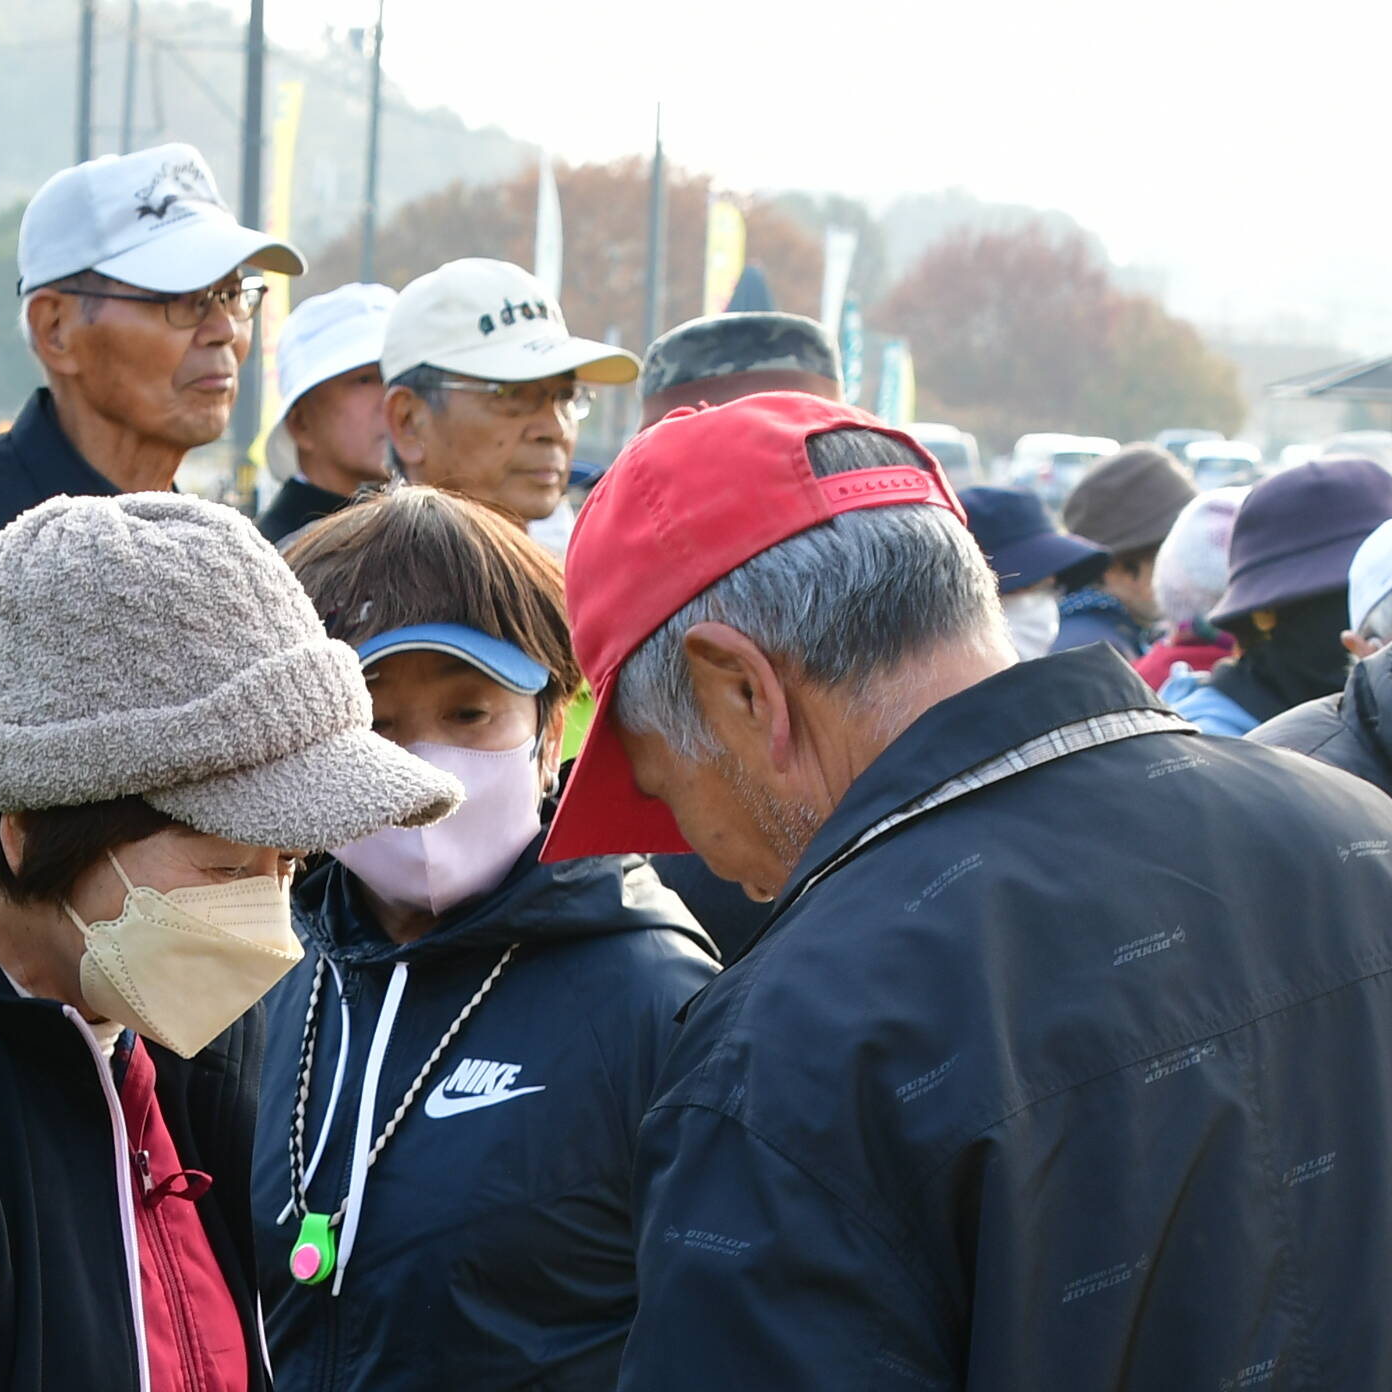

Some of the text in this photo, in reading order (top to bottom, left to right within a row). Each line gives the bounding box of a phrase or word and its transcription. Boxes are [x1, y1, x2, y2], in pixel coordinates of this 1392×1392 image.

[922, 853, 981, 897] DUNLOP
[1113, 939, 1171, 966] DUNLOP
[445, 1059, 522, 1096] NIKE
[1145, 1054, 1201, 1084] DUNLOP
[686, 1230, 752, 1250] DUNLOP
[1062, 1270, 1133, 1303] DUNLOP
